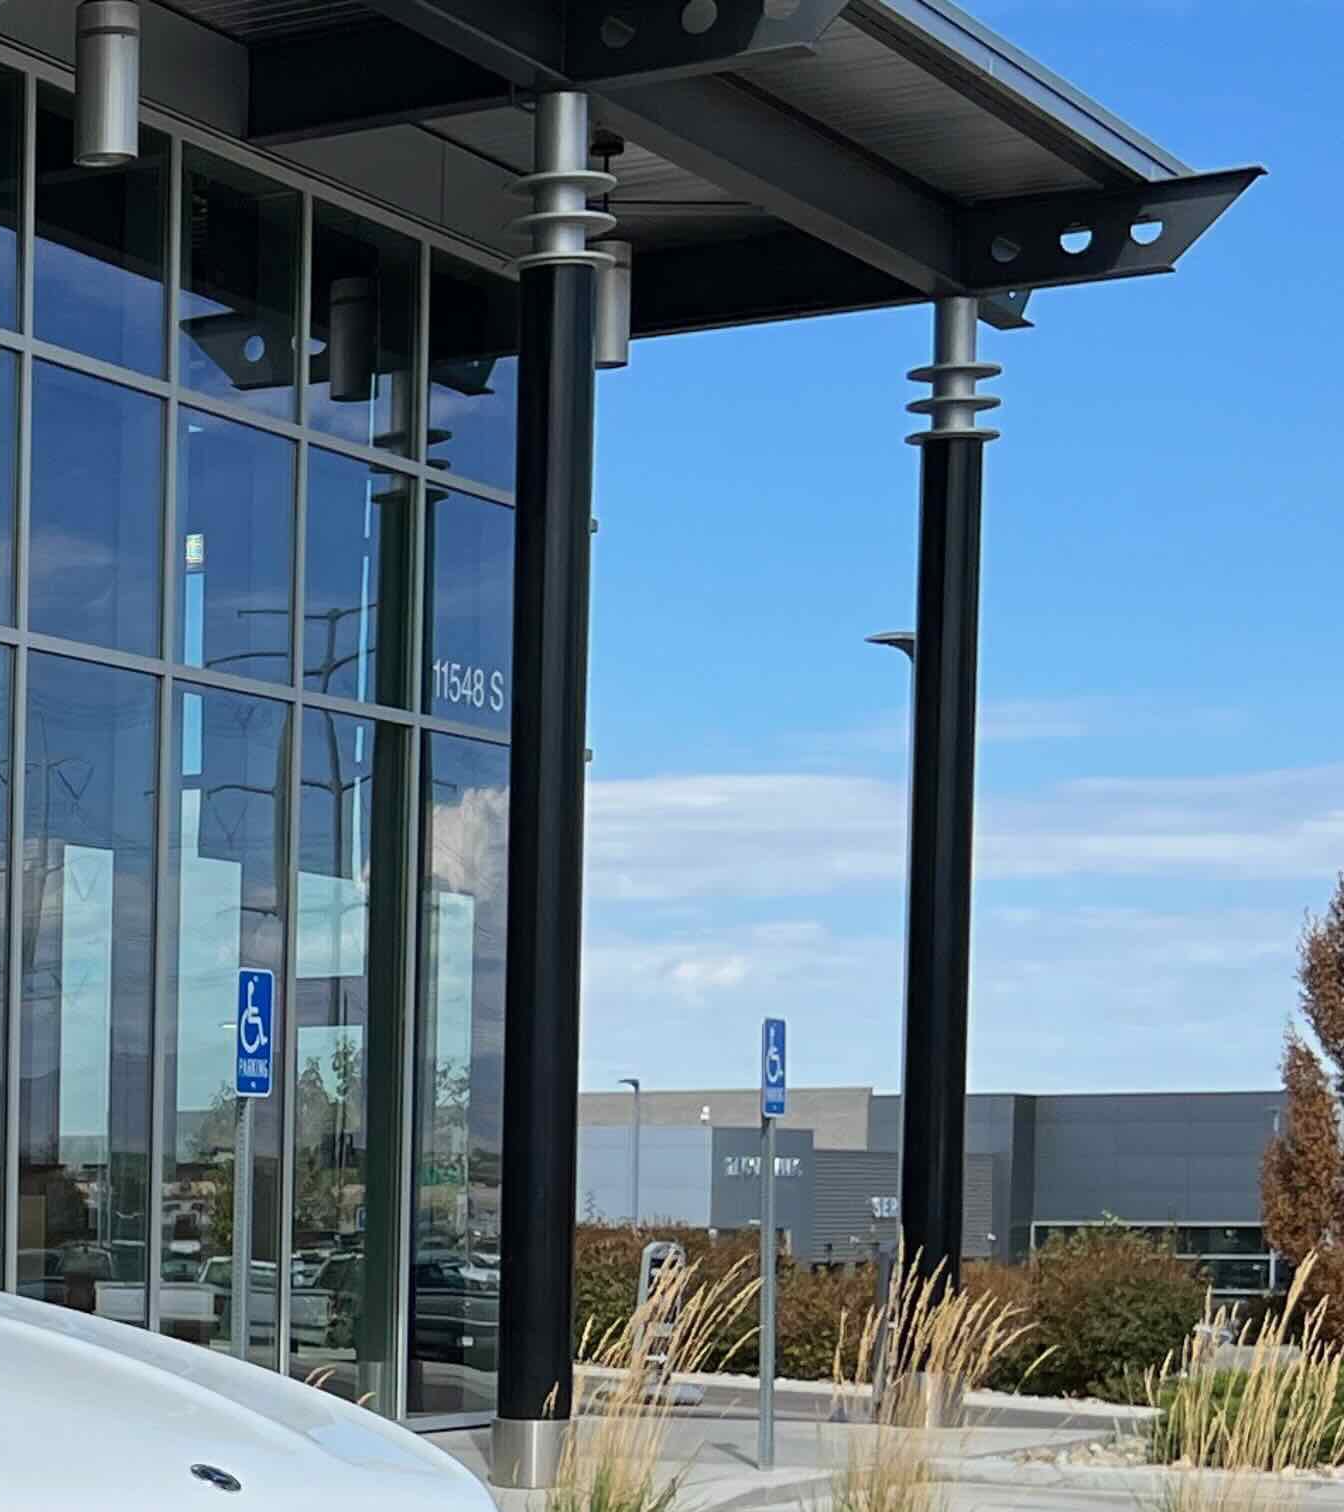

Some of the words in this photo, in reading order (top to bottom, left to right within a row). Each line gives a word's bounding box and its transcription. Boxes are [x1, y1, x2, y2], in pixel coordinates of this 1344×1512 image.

[433, 659, 484, 708] 11548
[490, 670, 504, 712] S
[239, 1058, 268, 1078] PARKING
